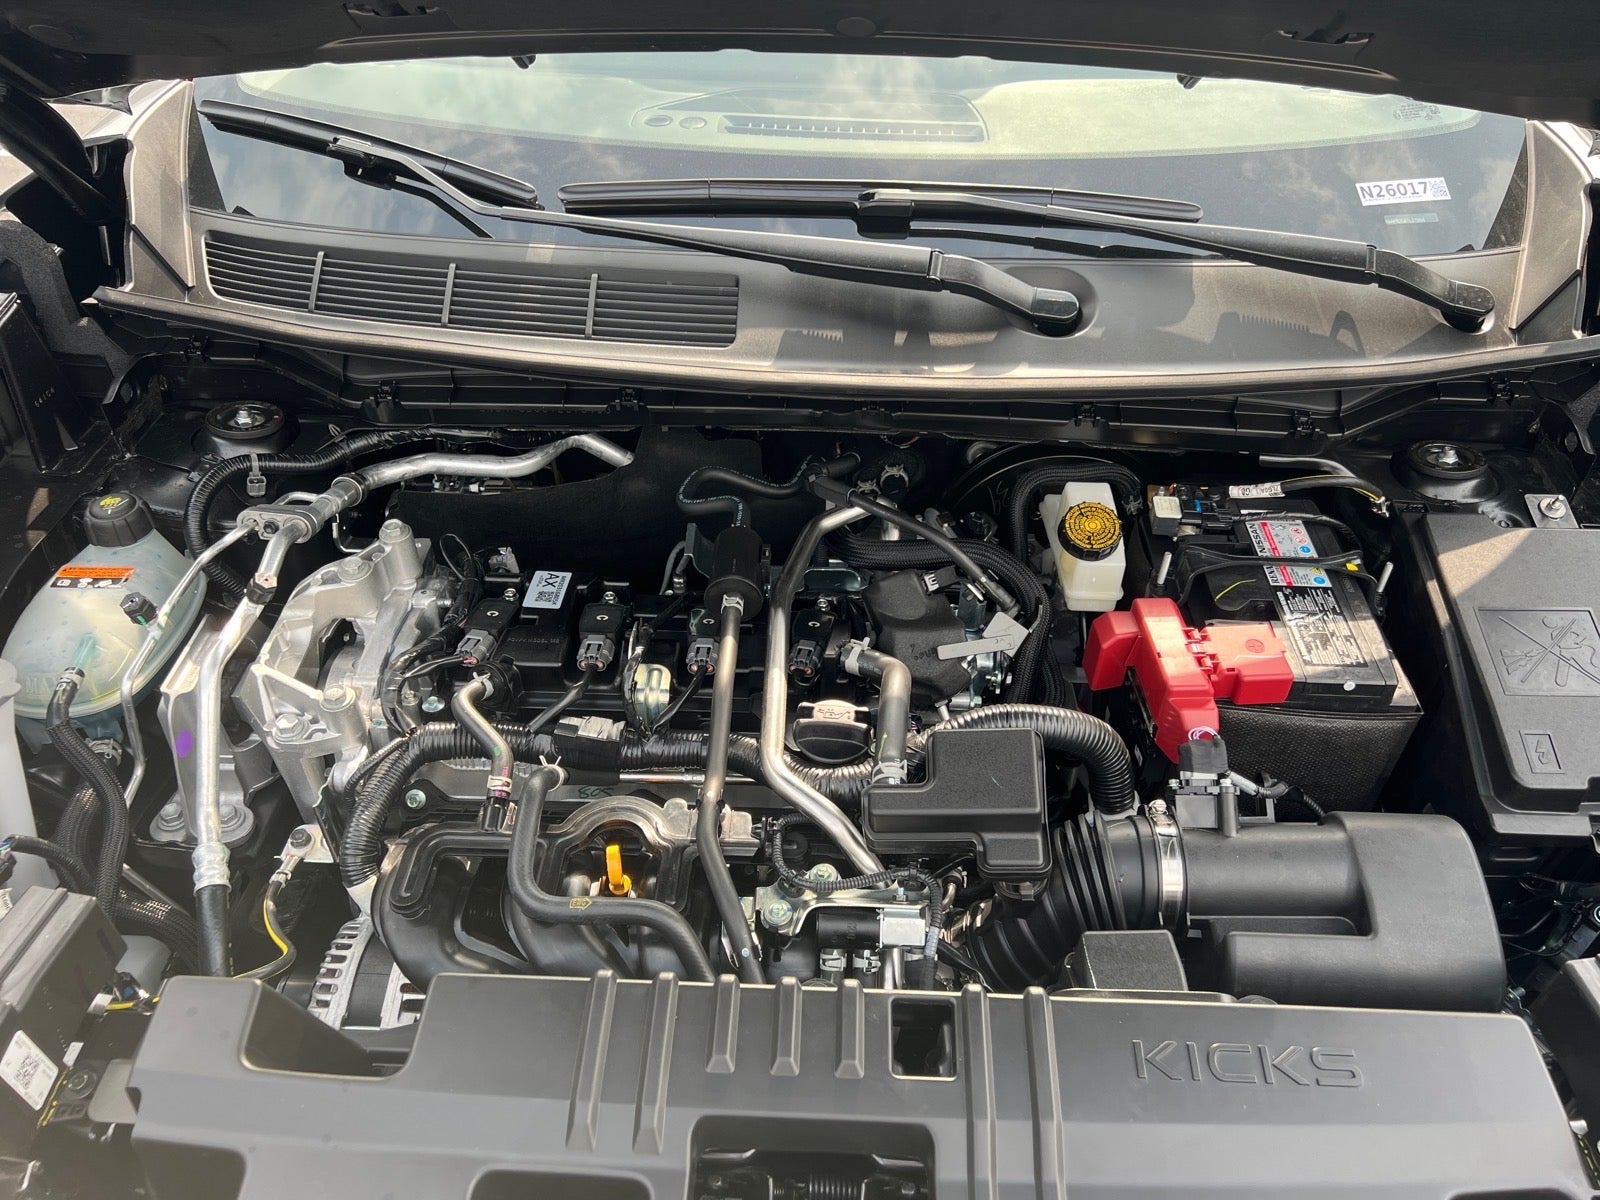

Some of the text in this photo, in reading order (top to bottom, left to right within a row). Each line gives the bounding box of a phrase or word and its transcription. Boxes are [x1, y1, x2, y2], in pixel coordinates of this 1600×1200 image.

[1359, 181, 1428, 199] N26017
[1248, 522, 1267, 554] NISSAN
[542, 572, 560, 588] AX
[1132, 1039, 1364, 1087] KICKS
